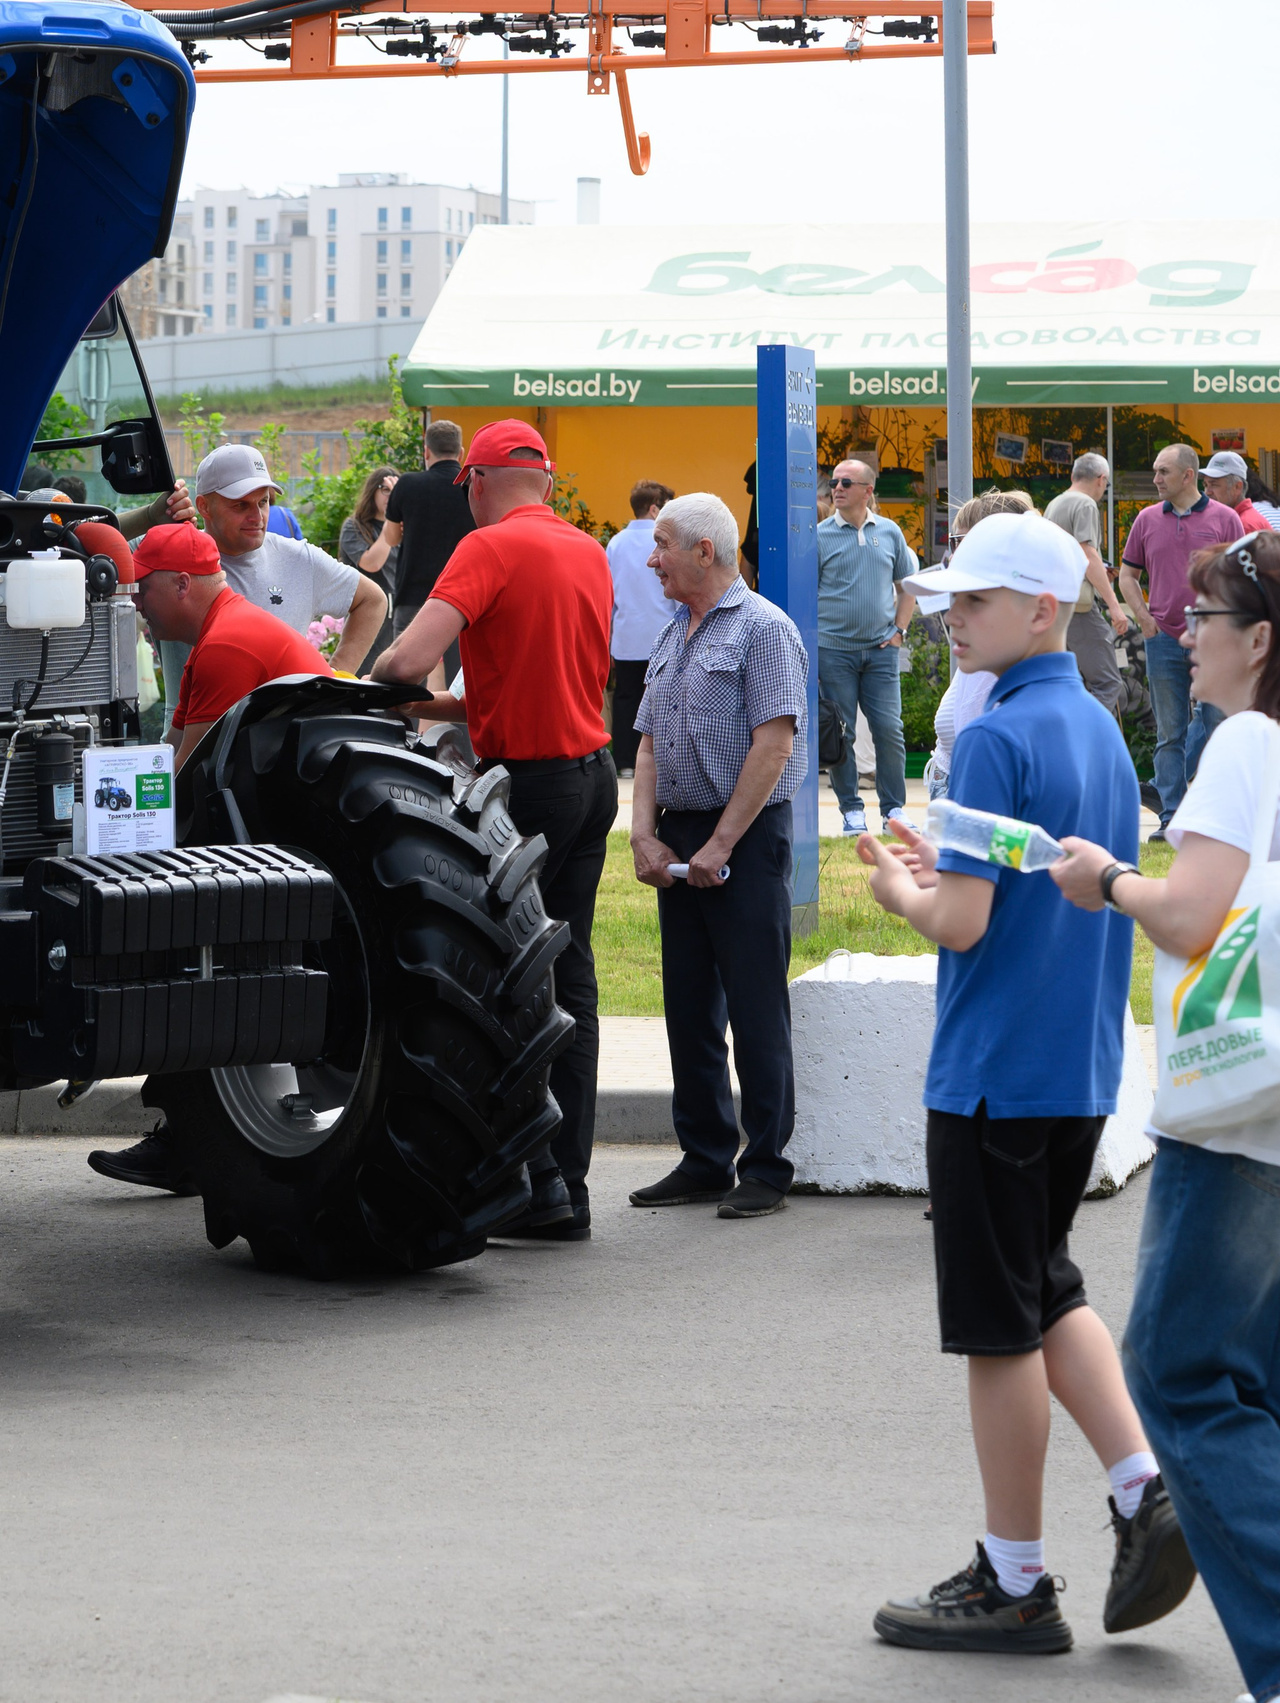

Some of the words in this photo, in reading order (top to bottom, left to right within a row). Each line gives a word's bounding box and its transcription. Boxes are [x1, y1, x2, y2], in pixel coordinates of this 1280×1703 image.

[513, 372, 642, 403] belsad.by
[788, 370, 803, 393] EXIT
[107, 813, 132, 821] Трактор
[1167, 1028, 1262, 1071] ПЕРЕДОВЫЕ
